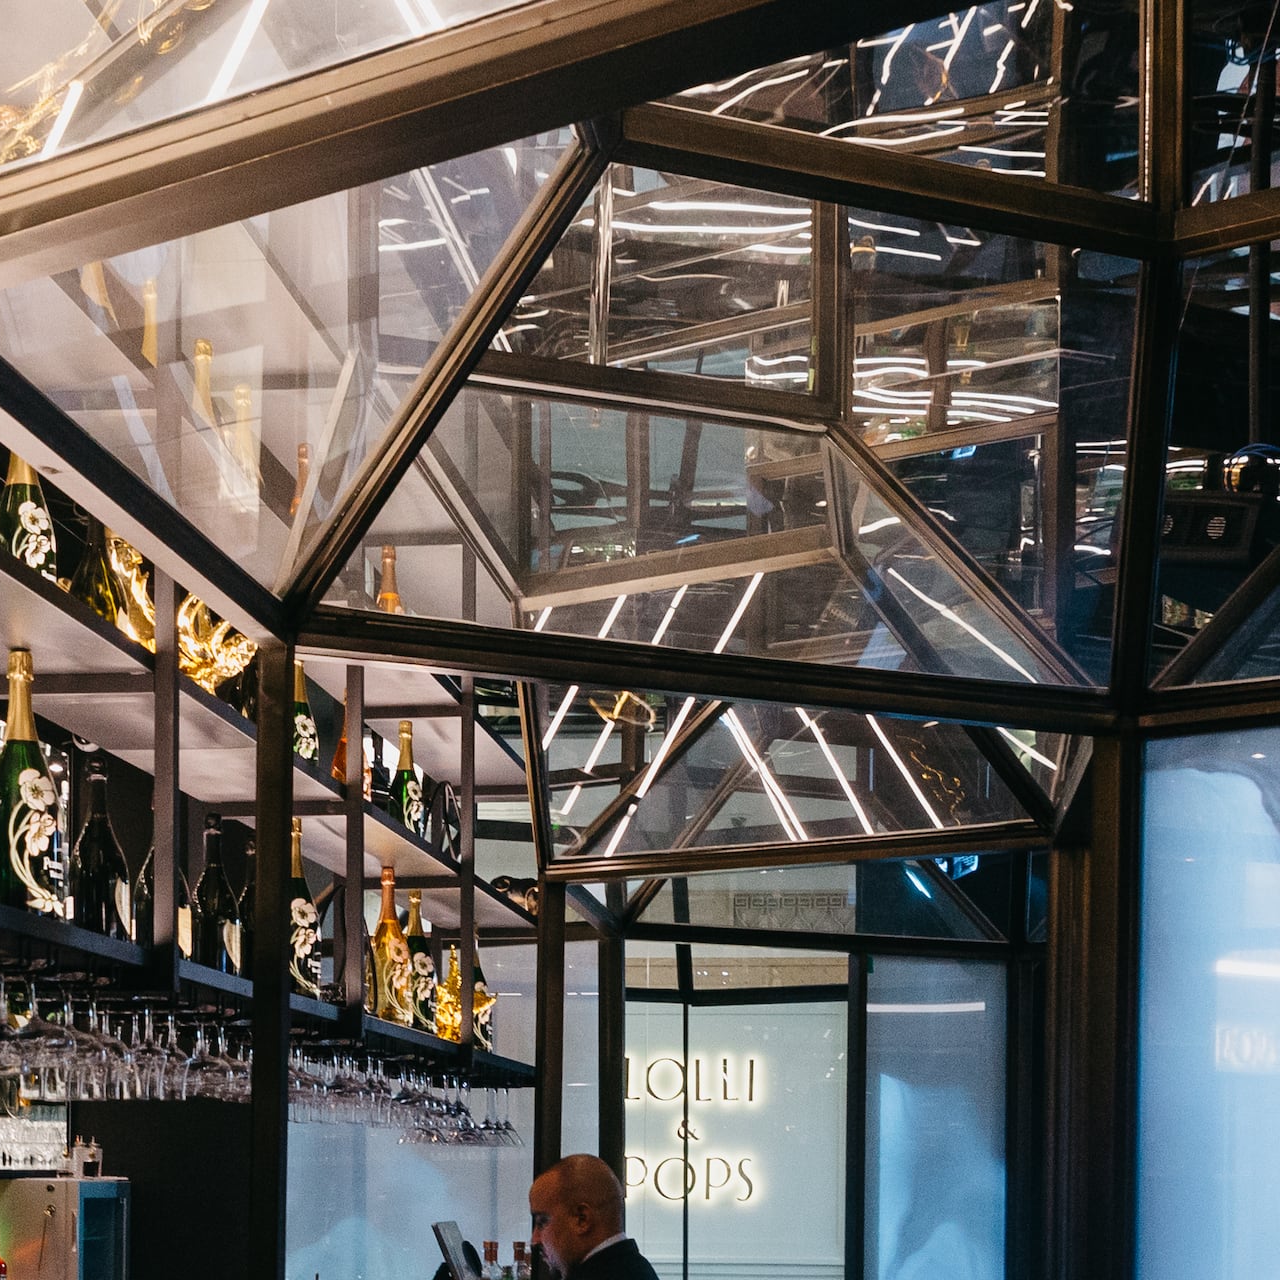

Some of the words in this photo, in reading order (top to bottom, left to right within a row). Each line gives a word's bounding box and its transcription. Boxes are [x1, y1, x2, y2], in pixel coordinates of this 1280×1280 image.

[624, 1057, 755, 1102] LOLLI
[676, 1118, 700, 1141] &
[624, 1155, 754, 1202] POPS
